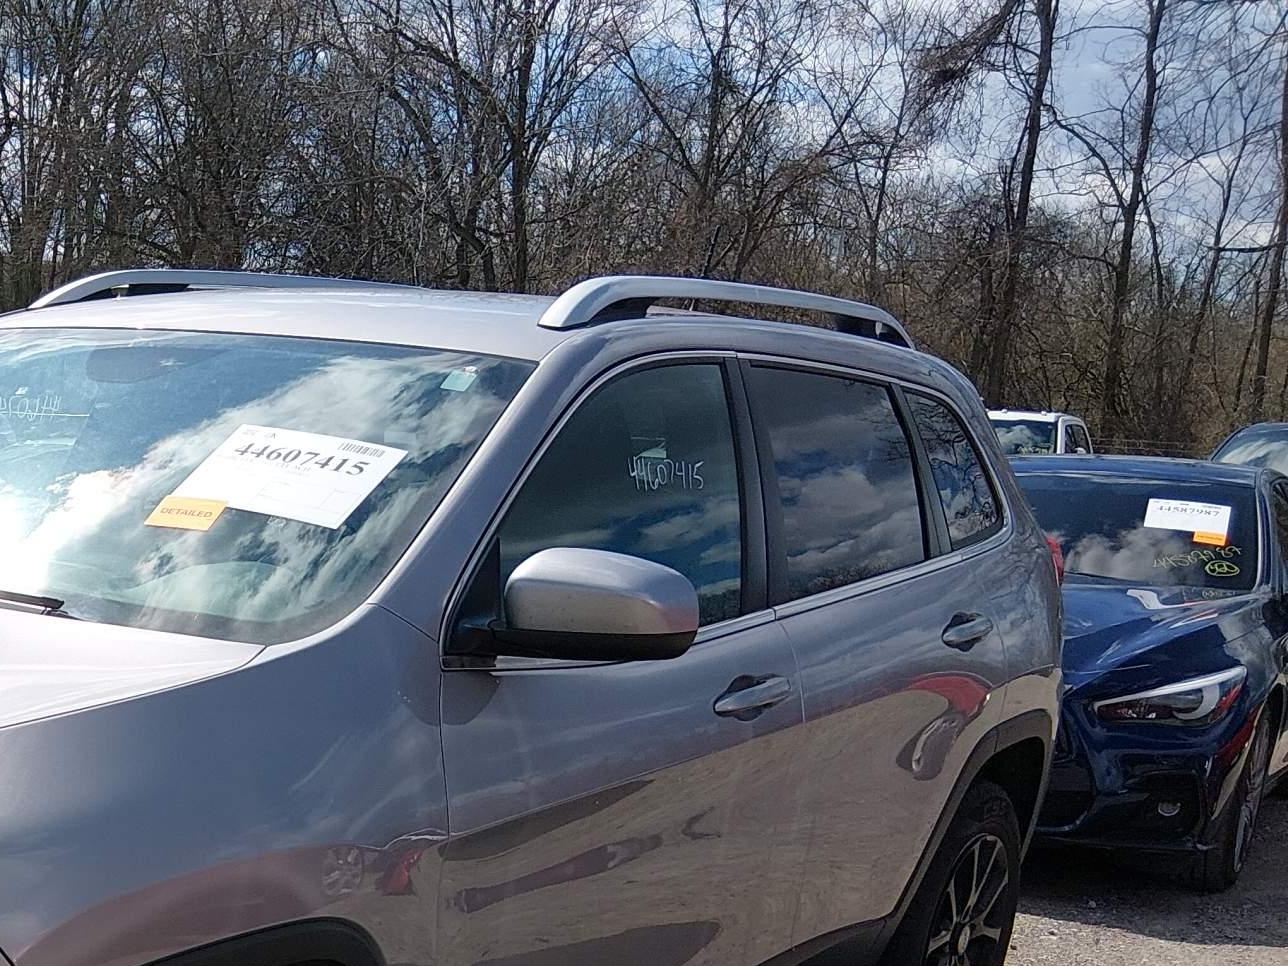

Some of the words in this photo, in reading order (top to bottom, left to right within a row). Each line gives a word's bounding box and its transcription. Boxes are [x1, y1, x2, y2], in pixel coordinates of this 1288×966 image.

[235, 441, 371, 477] 44607415
[627, 456, 704, 493] 44607415
[160, 506, 213, 519] DETAILED
